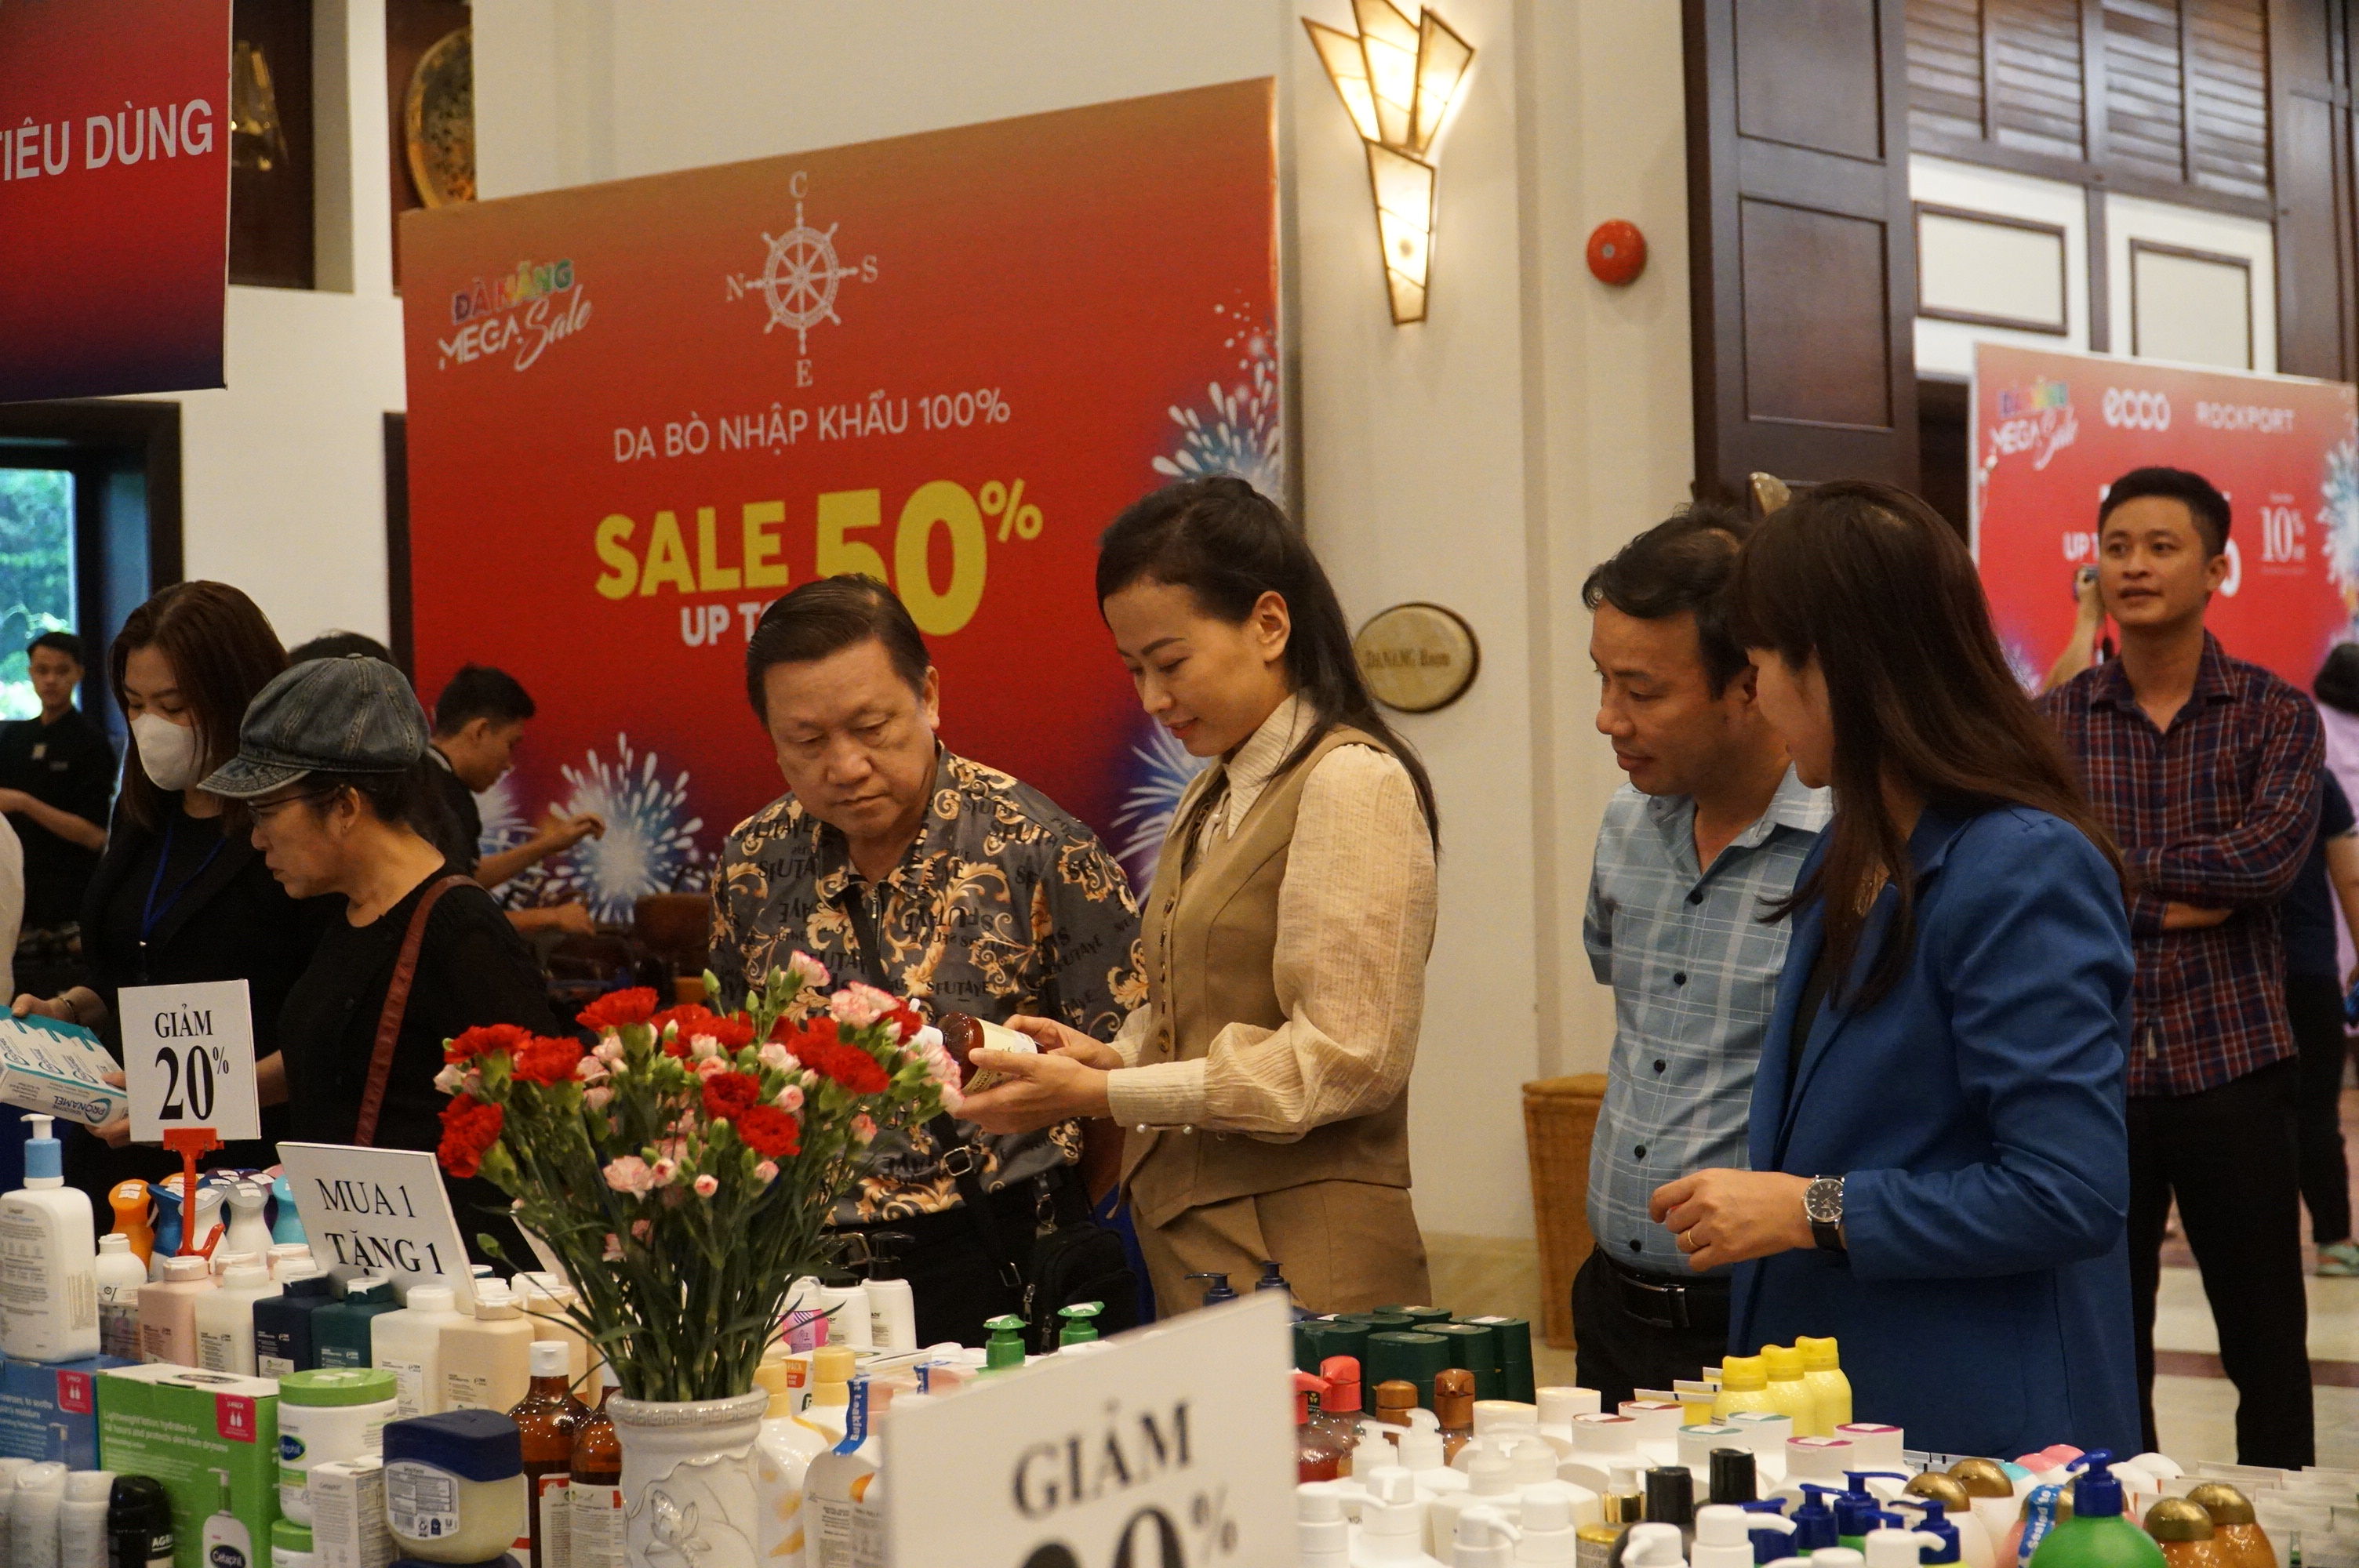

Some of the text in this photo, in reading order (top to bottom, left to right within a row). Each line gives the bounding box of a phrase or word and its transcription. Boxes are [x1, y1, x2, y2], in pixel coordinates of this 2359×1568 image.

[0, 99, 213, 181] IÊU DÙNG
[789, 170, 809, 198] C
[862, 255, 878, 283] S
[438, 283, 593, 372] MEGA Sale
[796, 358, 813, 388] E
[614, 426, 656, 463] DA
[665, 412, 709, 458] BÒ
[718, 402, 809, 456] NHẬP
[918, 388, 1012, 430] 100%
[2103, 387, 2171, 431] ecco
[594, 500, 789, 601] SALE
[680, 601, 779, 648] UP T
[154, 1004, 213, 1038] GIẢM
[54, 1095, 106, 1117] PRONAMEL
[155, 1046, 230, 1120] 20%
[315, 1178, 416, 1218] MUA 1
[325, 1229, 445, 1276] TẶNG 1
[1012, 1399, 1193, 1522] GIẢM
